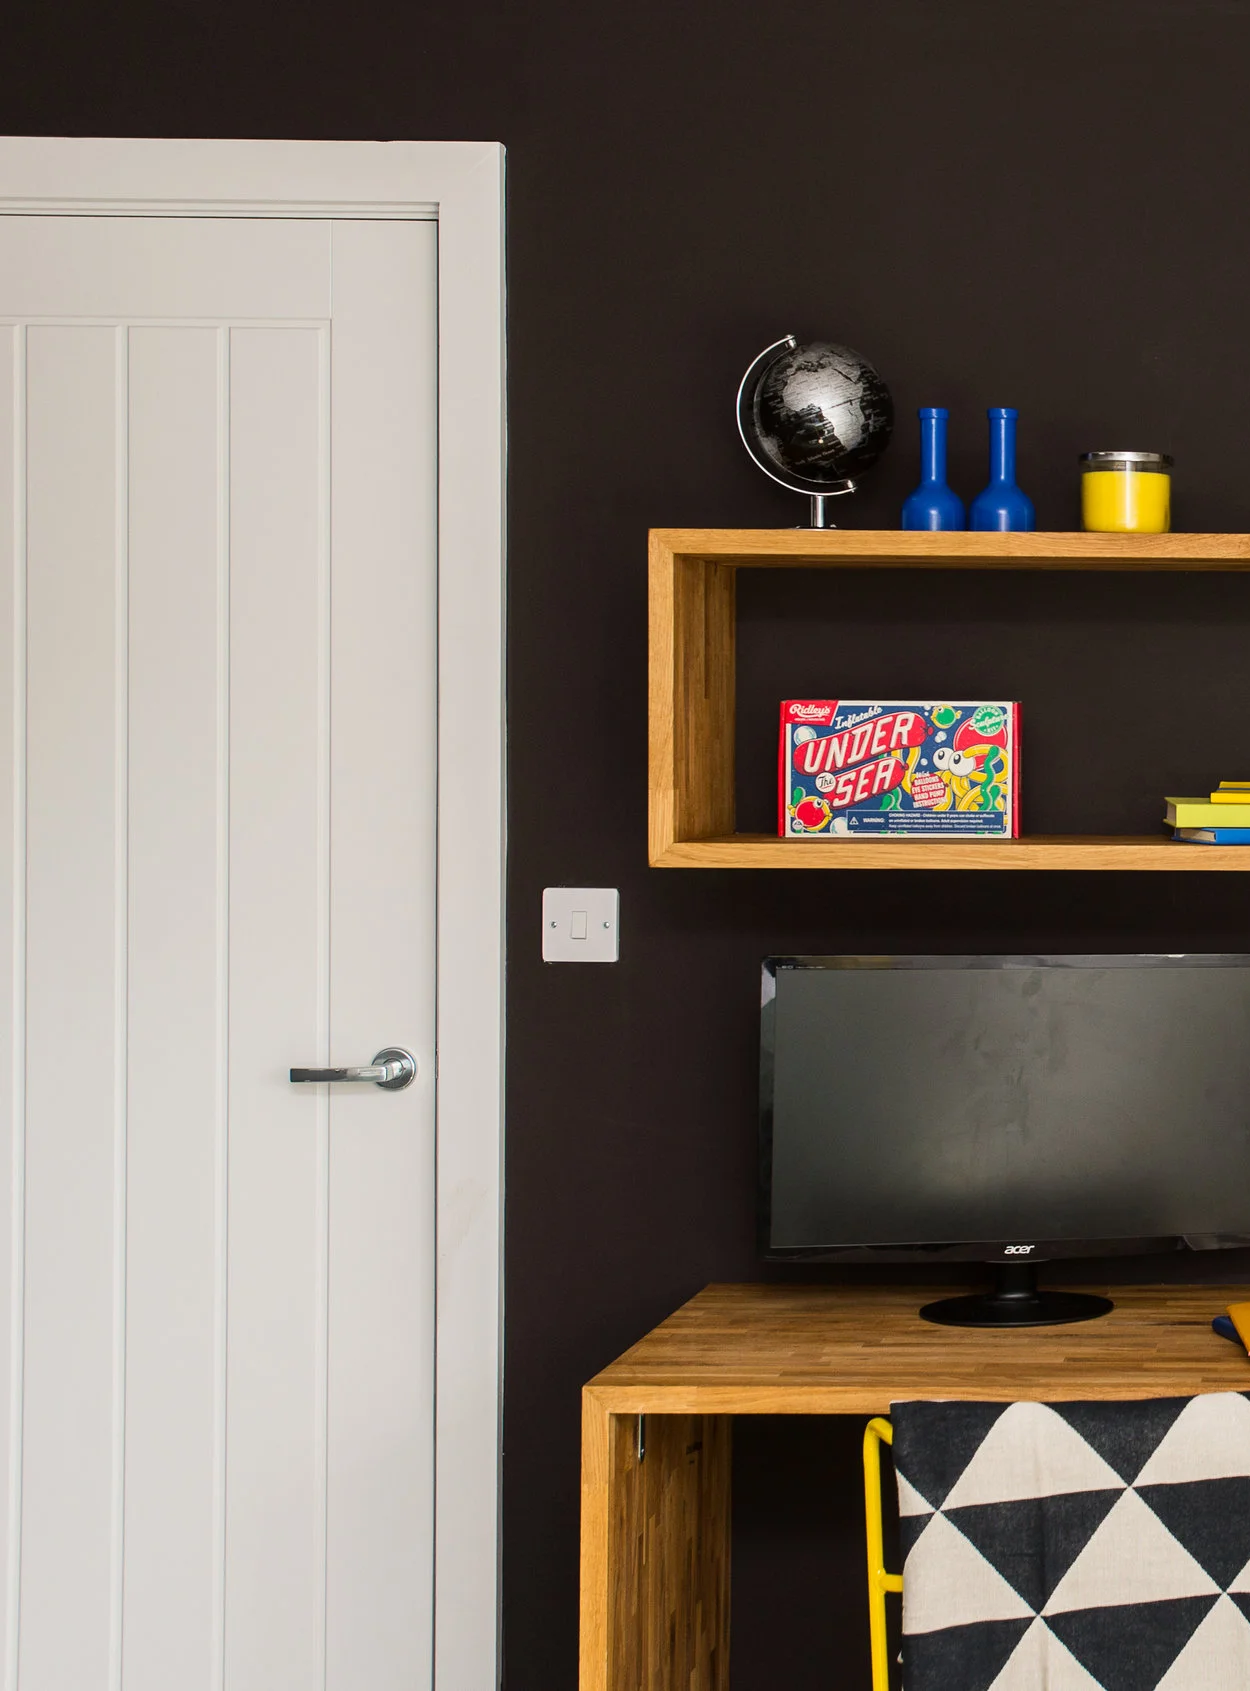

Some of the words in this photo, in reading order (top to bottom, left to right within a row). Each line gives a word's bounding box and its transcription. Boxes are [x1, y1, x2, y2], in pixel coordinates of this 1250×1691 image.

[789, 703, 831, 718] Ridley's
[835, 704, 883, 729] Inflatable
[803, 713, 915, 773] UNDER
[818, 776, 834, 788] The
[833, 759, 896, 807] SEA
[1004, 1245, 1035, 1254] acer
